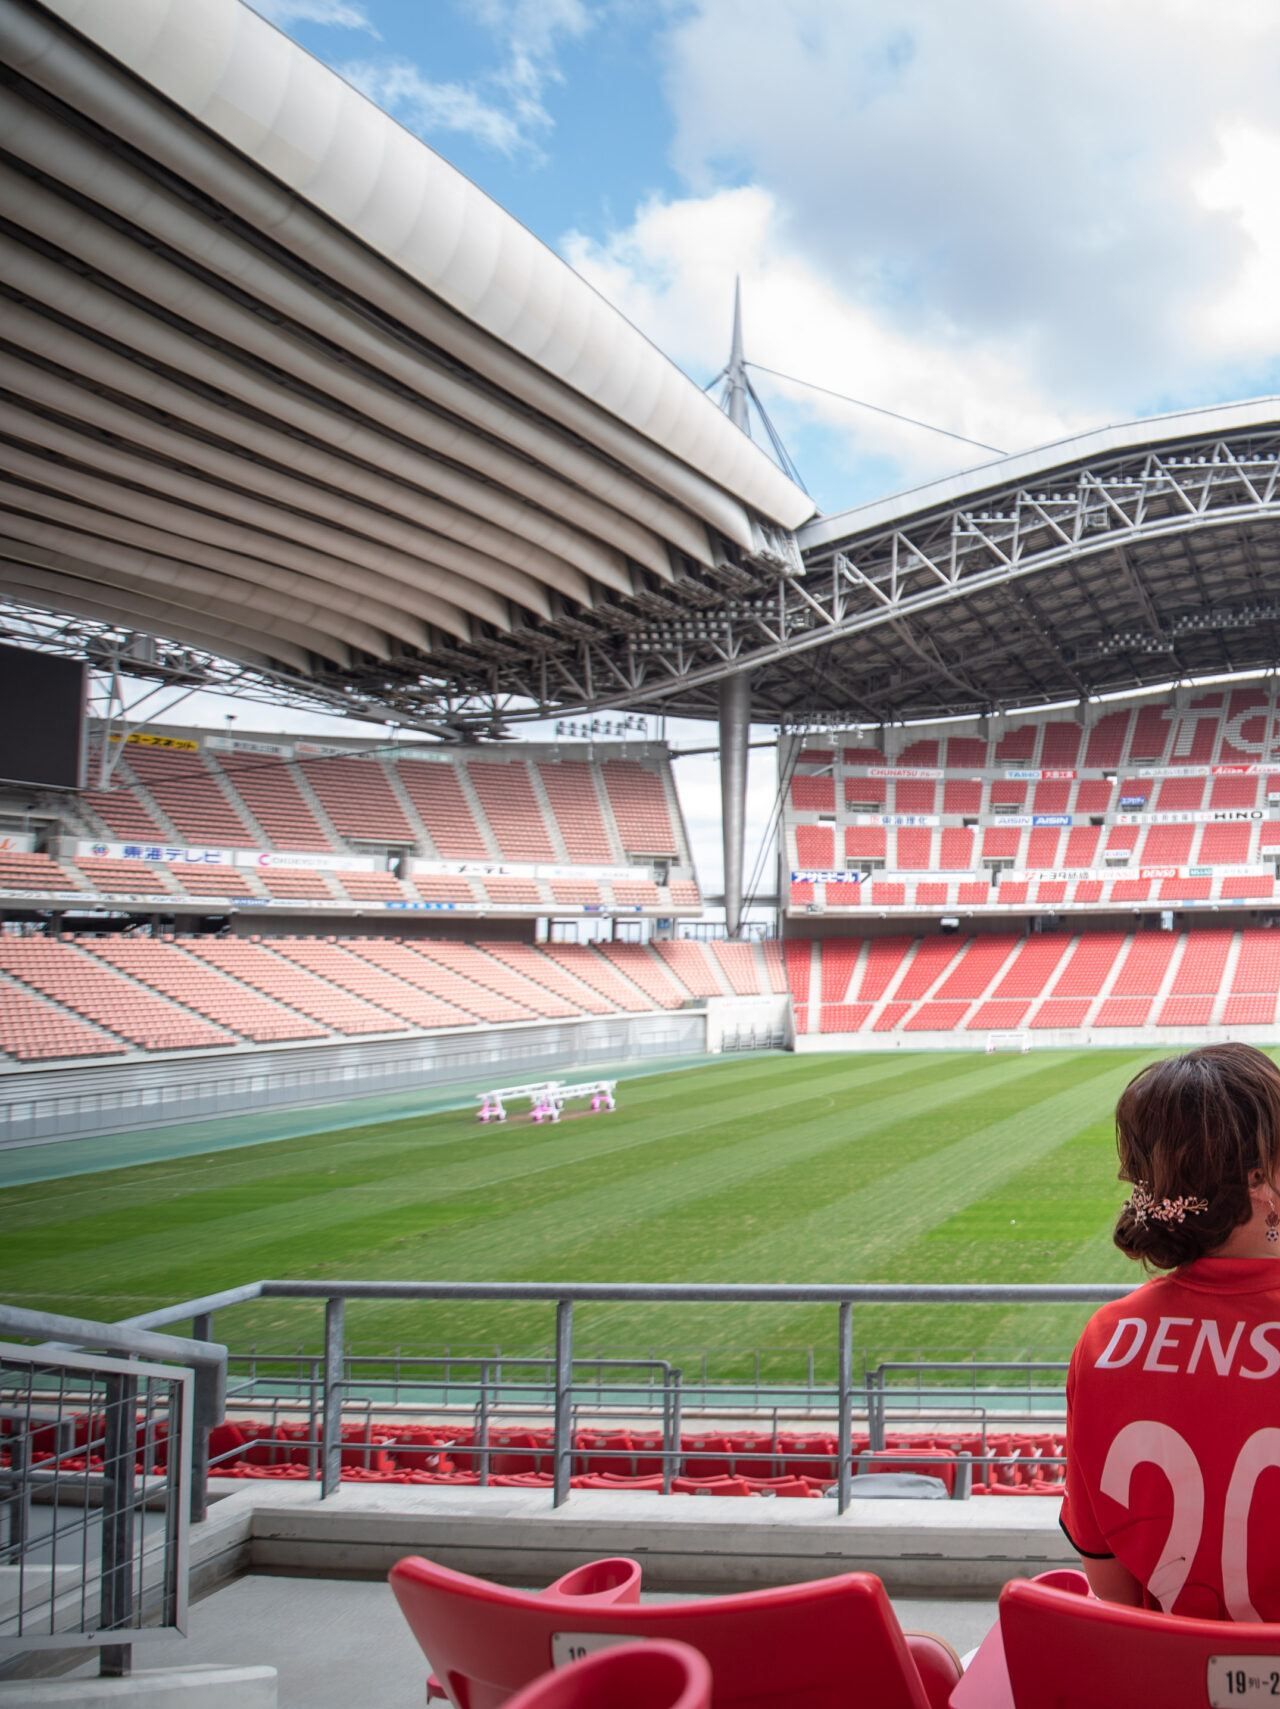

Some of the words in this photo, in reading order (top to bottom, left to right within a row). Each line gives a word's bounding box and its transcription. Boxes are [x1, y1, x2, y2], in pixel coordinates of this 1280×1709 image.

[1007, 770, 1041, 779] TAIHO
[1214, 811, 1263, 820] HINO
[1036, 816, 1070, 825] AISIN
[123, 844, 222, 864] 東海テレビ
[1141, 869, 1177, 879] DENSO
